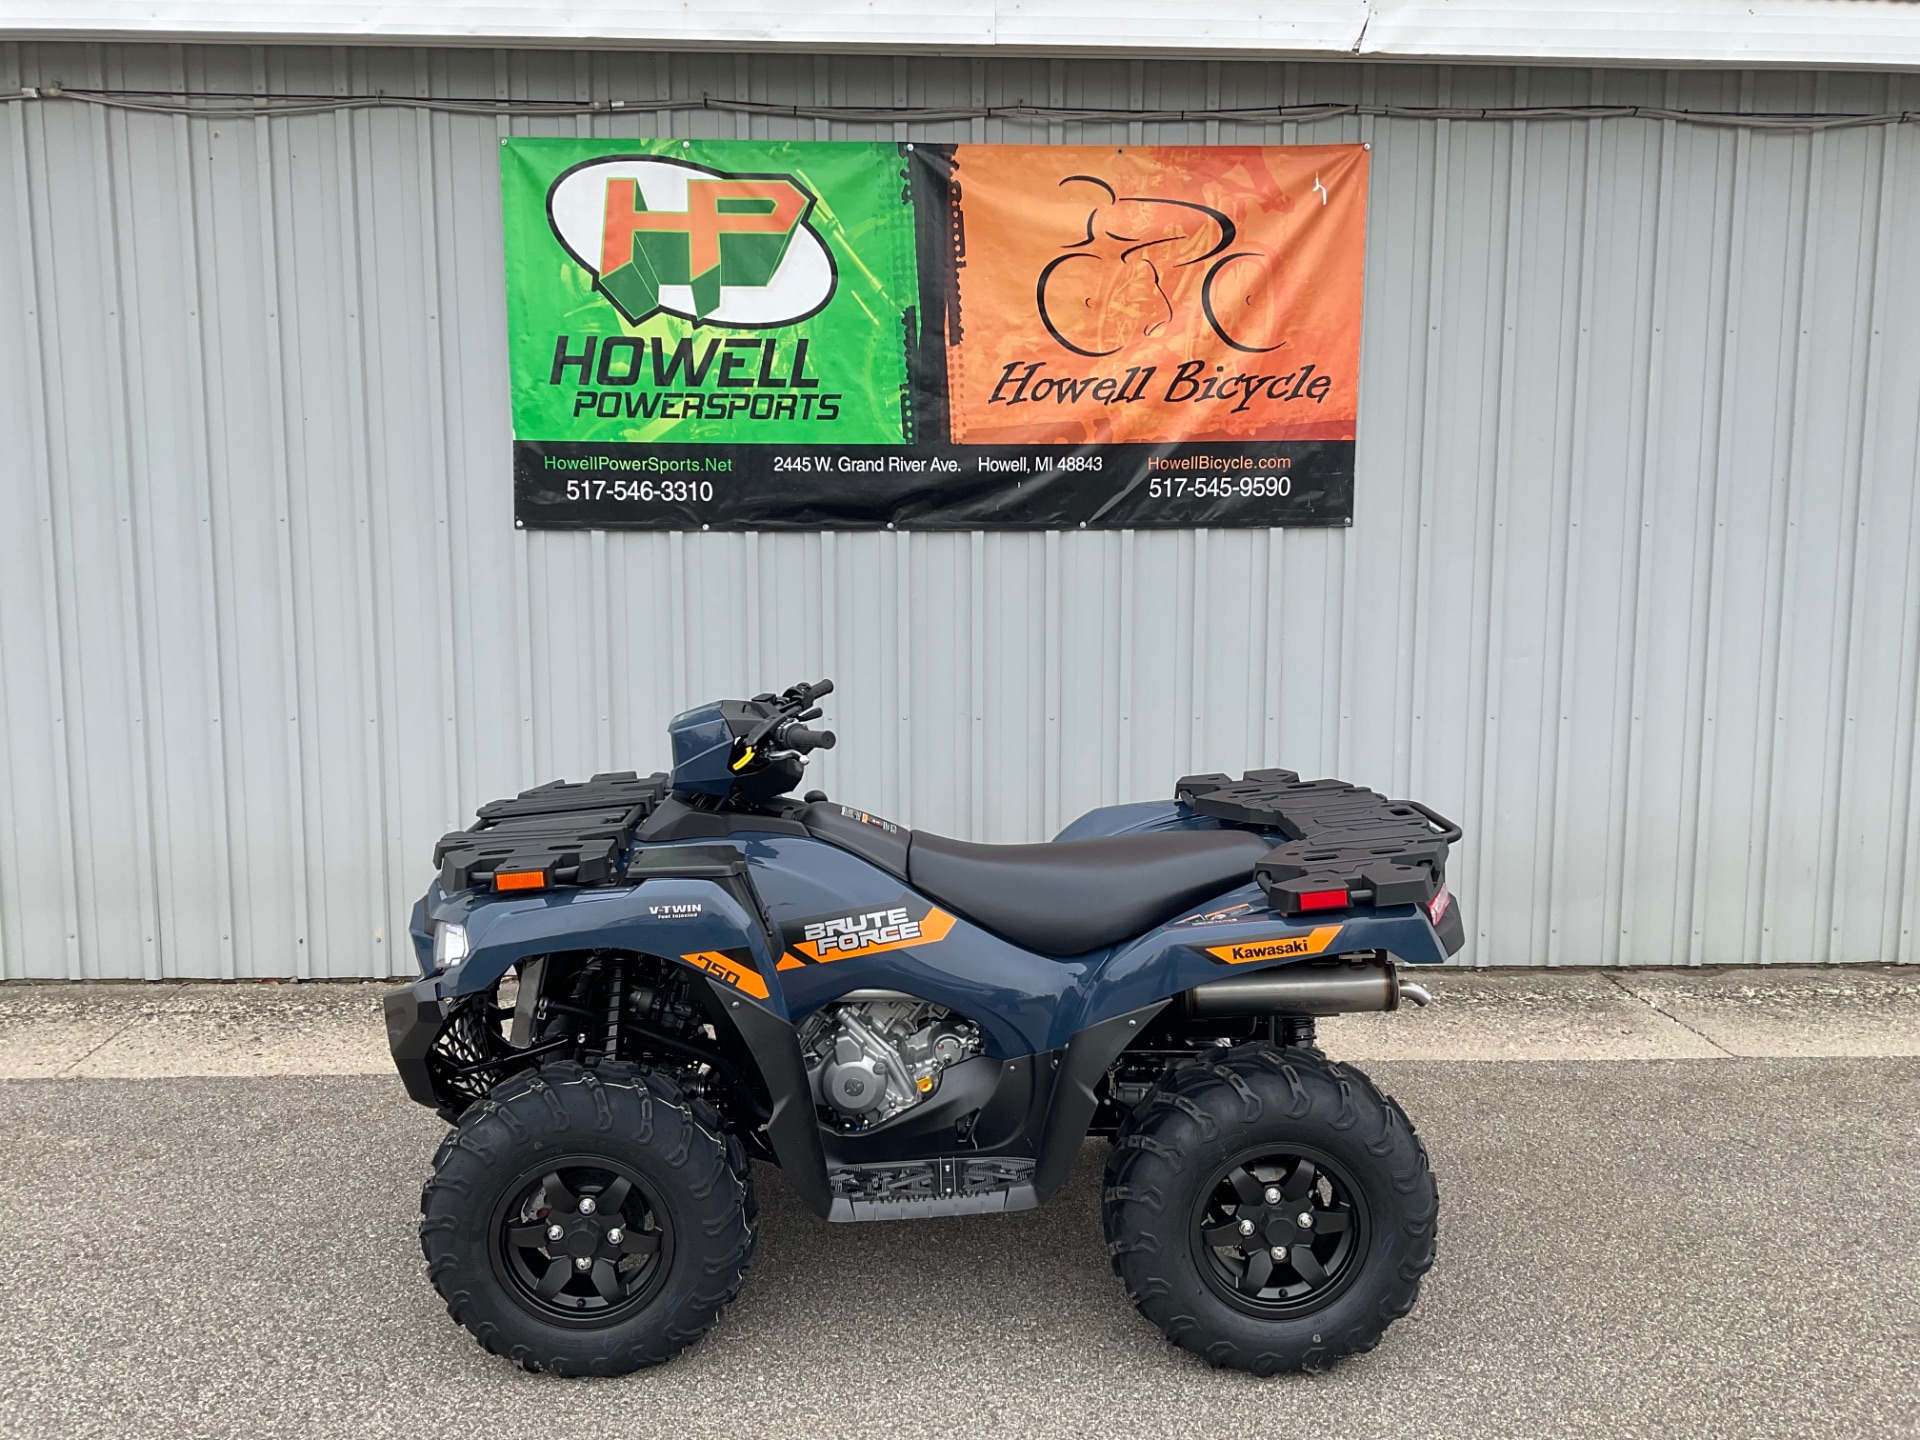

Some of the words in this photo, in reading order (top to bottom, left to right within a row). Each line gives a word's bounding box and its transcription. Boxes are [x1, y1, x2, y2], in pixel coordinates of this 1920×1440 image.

[600, 178, 809, 278] HP
[549, 335, 820, 388] HOWELL
[988, 361, 1157, 406] Howell
[1164, 360, 1332, 414] Bicycle
[573, 391, 842, 420] POWERSPORTS
[544, 456, 733, 473] HowellPowerSports.Net
[773, 457, 812, 473] 2445
[815, 457, 834, 473] W.
[838, 456, 885, 473] Grand
[888, 456, 927, 473] River
[930, 457, 962, 473] Ave.
[978, 457, 1031, 474] Howell,
[1035, 457, 1054, 472] MI
[1057, 457, 1103, 473] 48843
[1147, 455, 1291, 473] HowellBicycle.com
[566, 480, 714, 502] 517-546-3310
[1149, 477, 1291, 498] 517-545-9590
[649, 904, 702, 914] V-TWIN
[804, 907, 909, 941] BRUTE
[817, 921, 922, 955] FORCE
[1232, 940, 1309, 960] Kawasaki
[697, 954, 741, 985] 750
